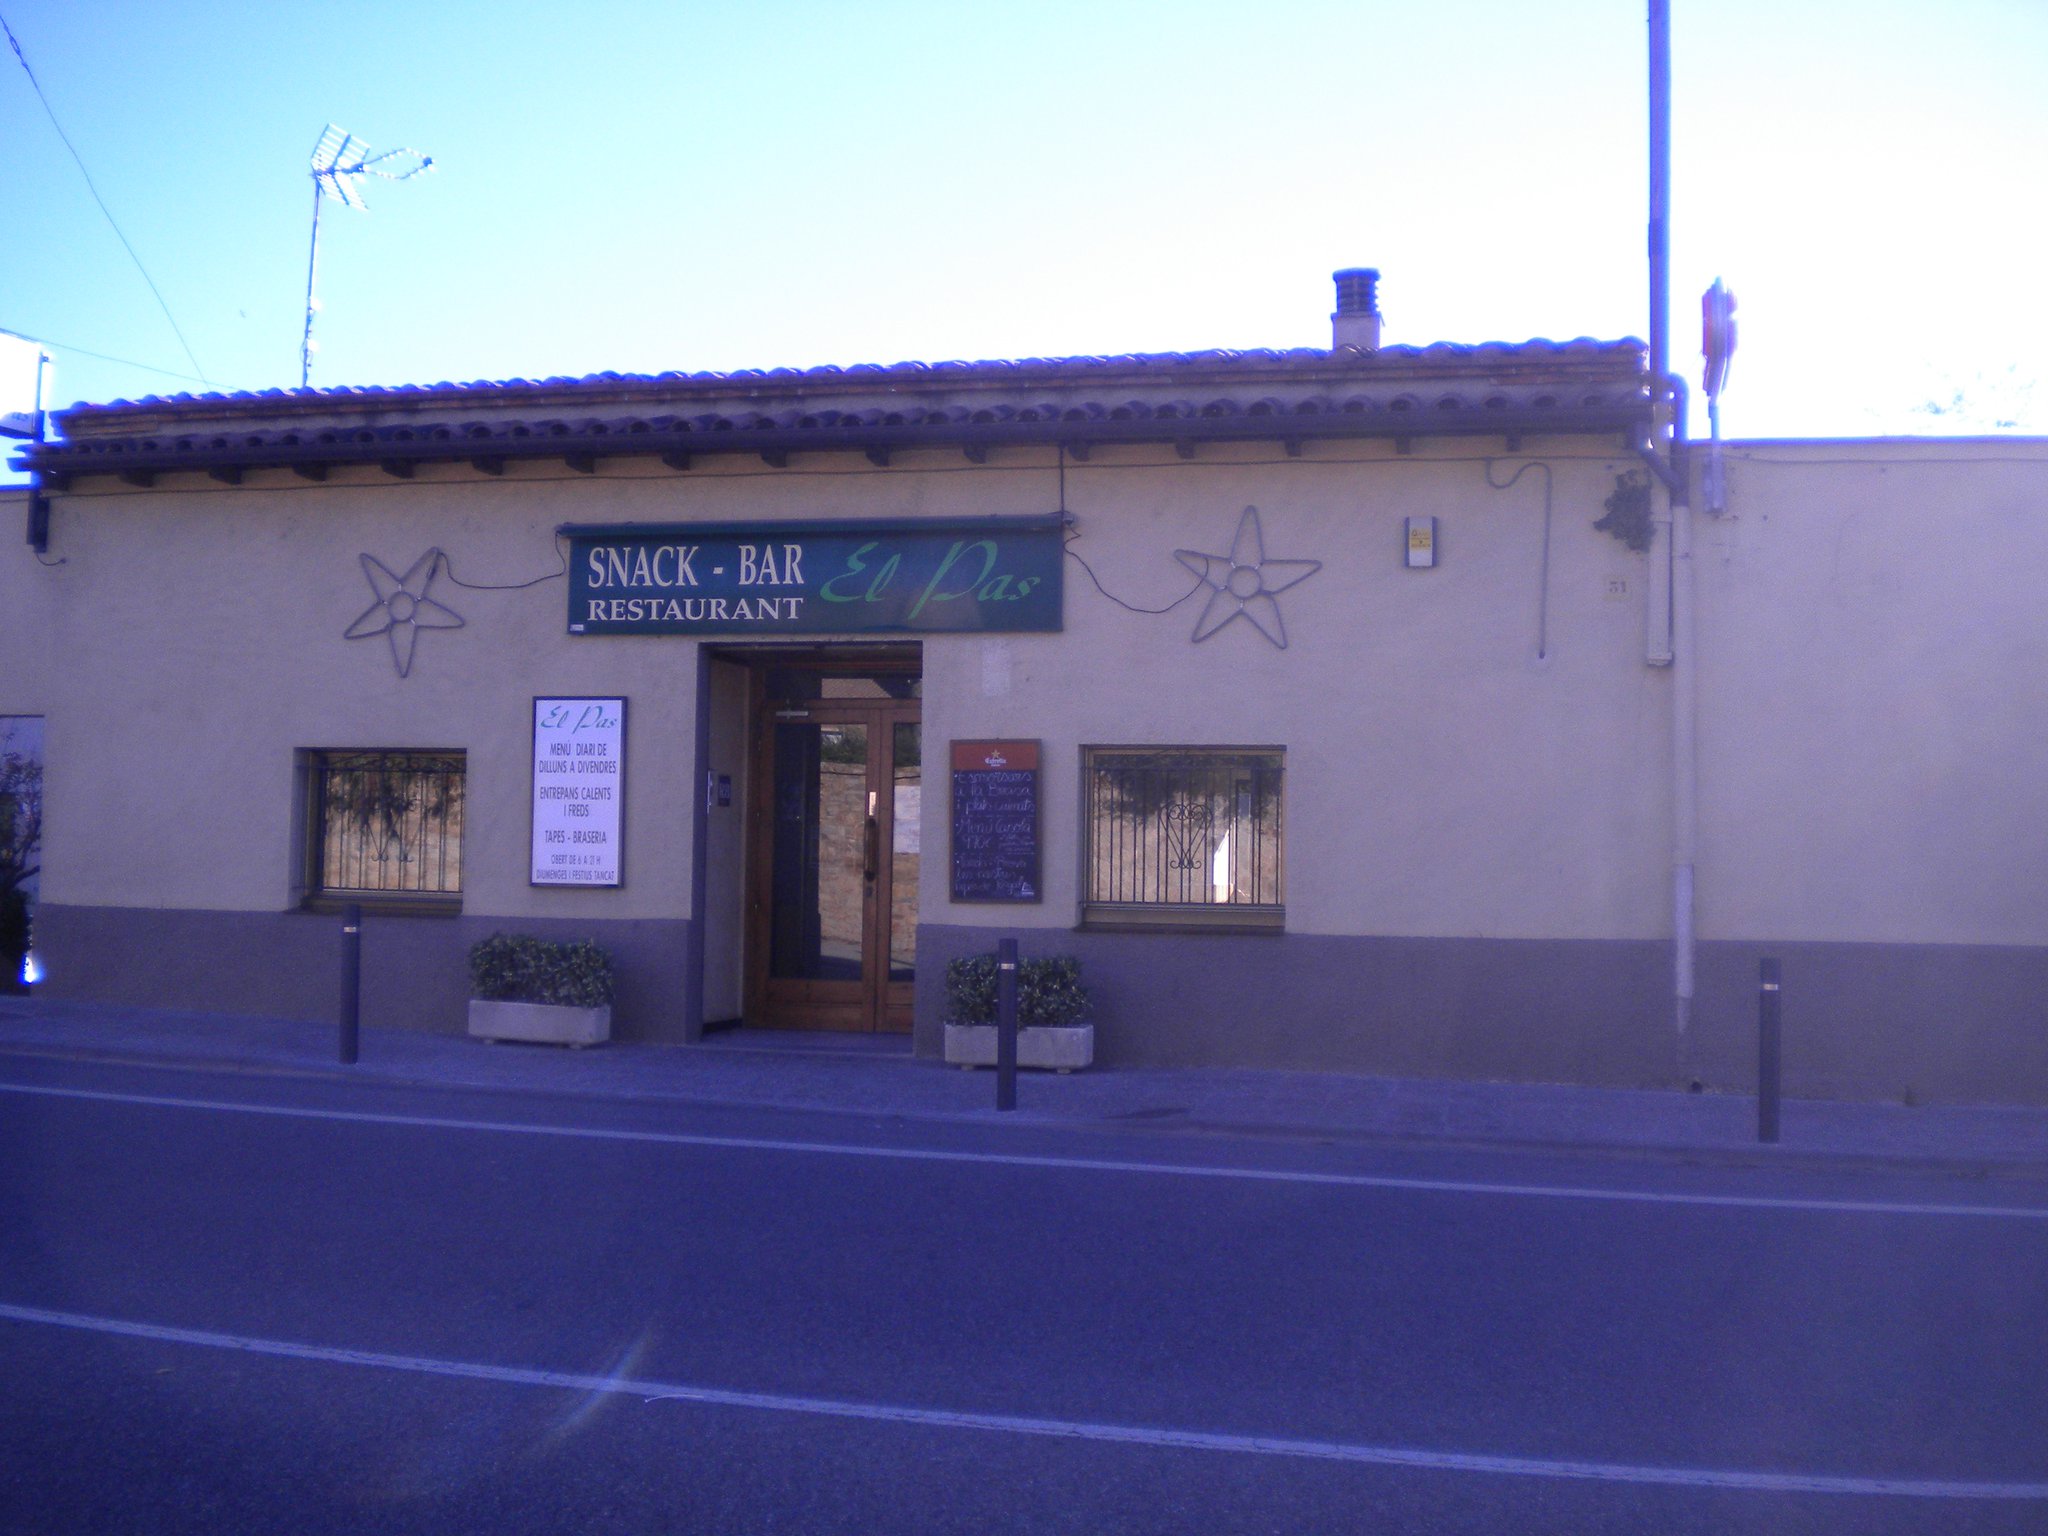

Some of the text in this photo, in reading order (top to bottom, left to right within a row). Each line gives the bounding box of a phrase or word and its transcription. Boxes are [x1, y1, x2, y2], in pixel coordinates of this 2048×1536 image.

[588, 545, 699, 588] SNACK
[738, 543, 804, 587] BAR
[820, 539, 1041, 620] El Pas
[588, 597, 804, 622] RESTAURANT
[540, 705, 618, 735] El Pas
[576, 743, 596, 756] DIARI
[597, 743, 608, 756] DE
[538, 760, 617, 774] DILLUNS A DIVENDRES
[540, 786, 611, 800] ENTREPANS CALENTS
[563, 804, 590, 817] I FREDS
[545, 829, 566, 843] TAPES
[572, 830, 607, 844] BRASERIA
[551, 854, 567, 865] OBERT
[568, 854, 577, 865] DE
[583, 855, 589, 866] A
[594, 870, 615, 882] TANCAT
